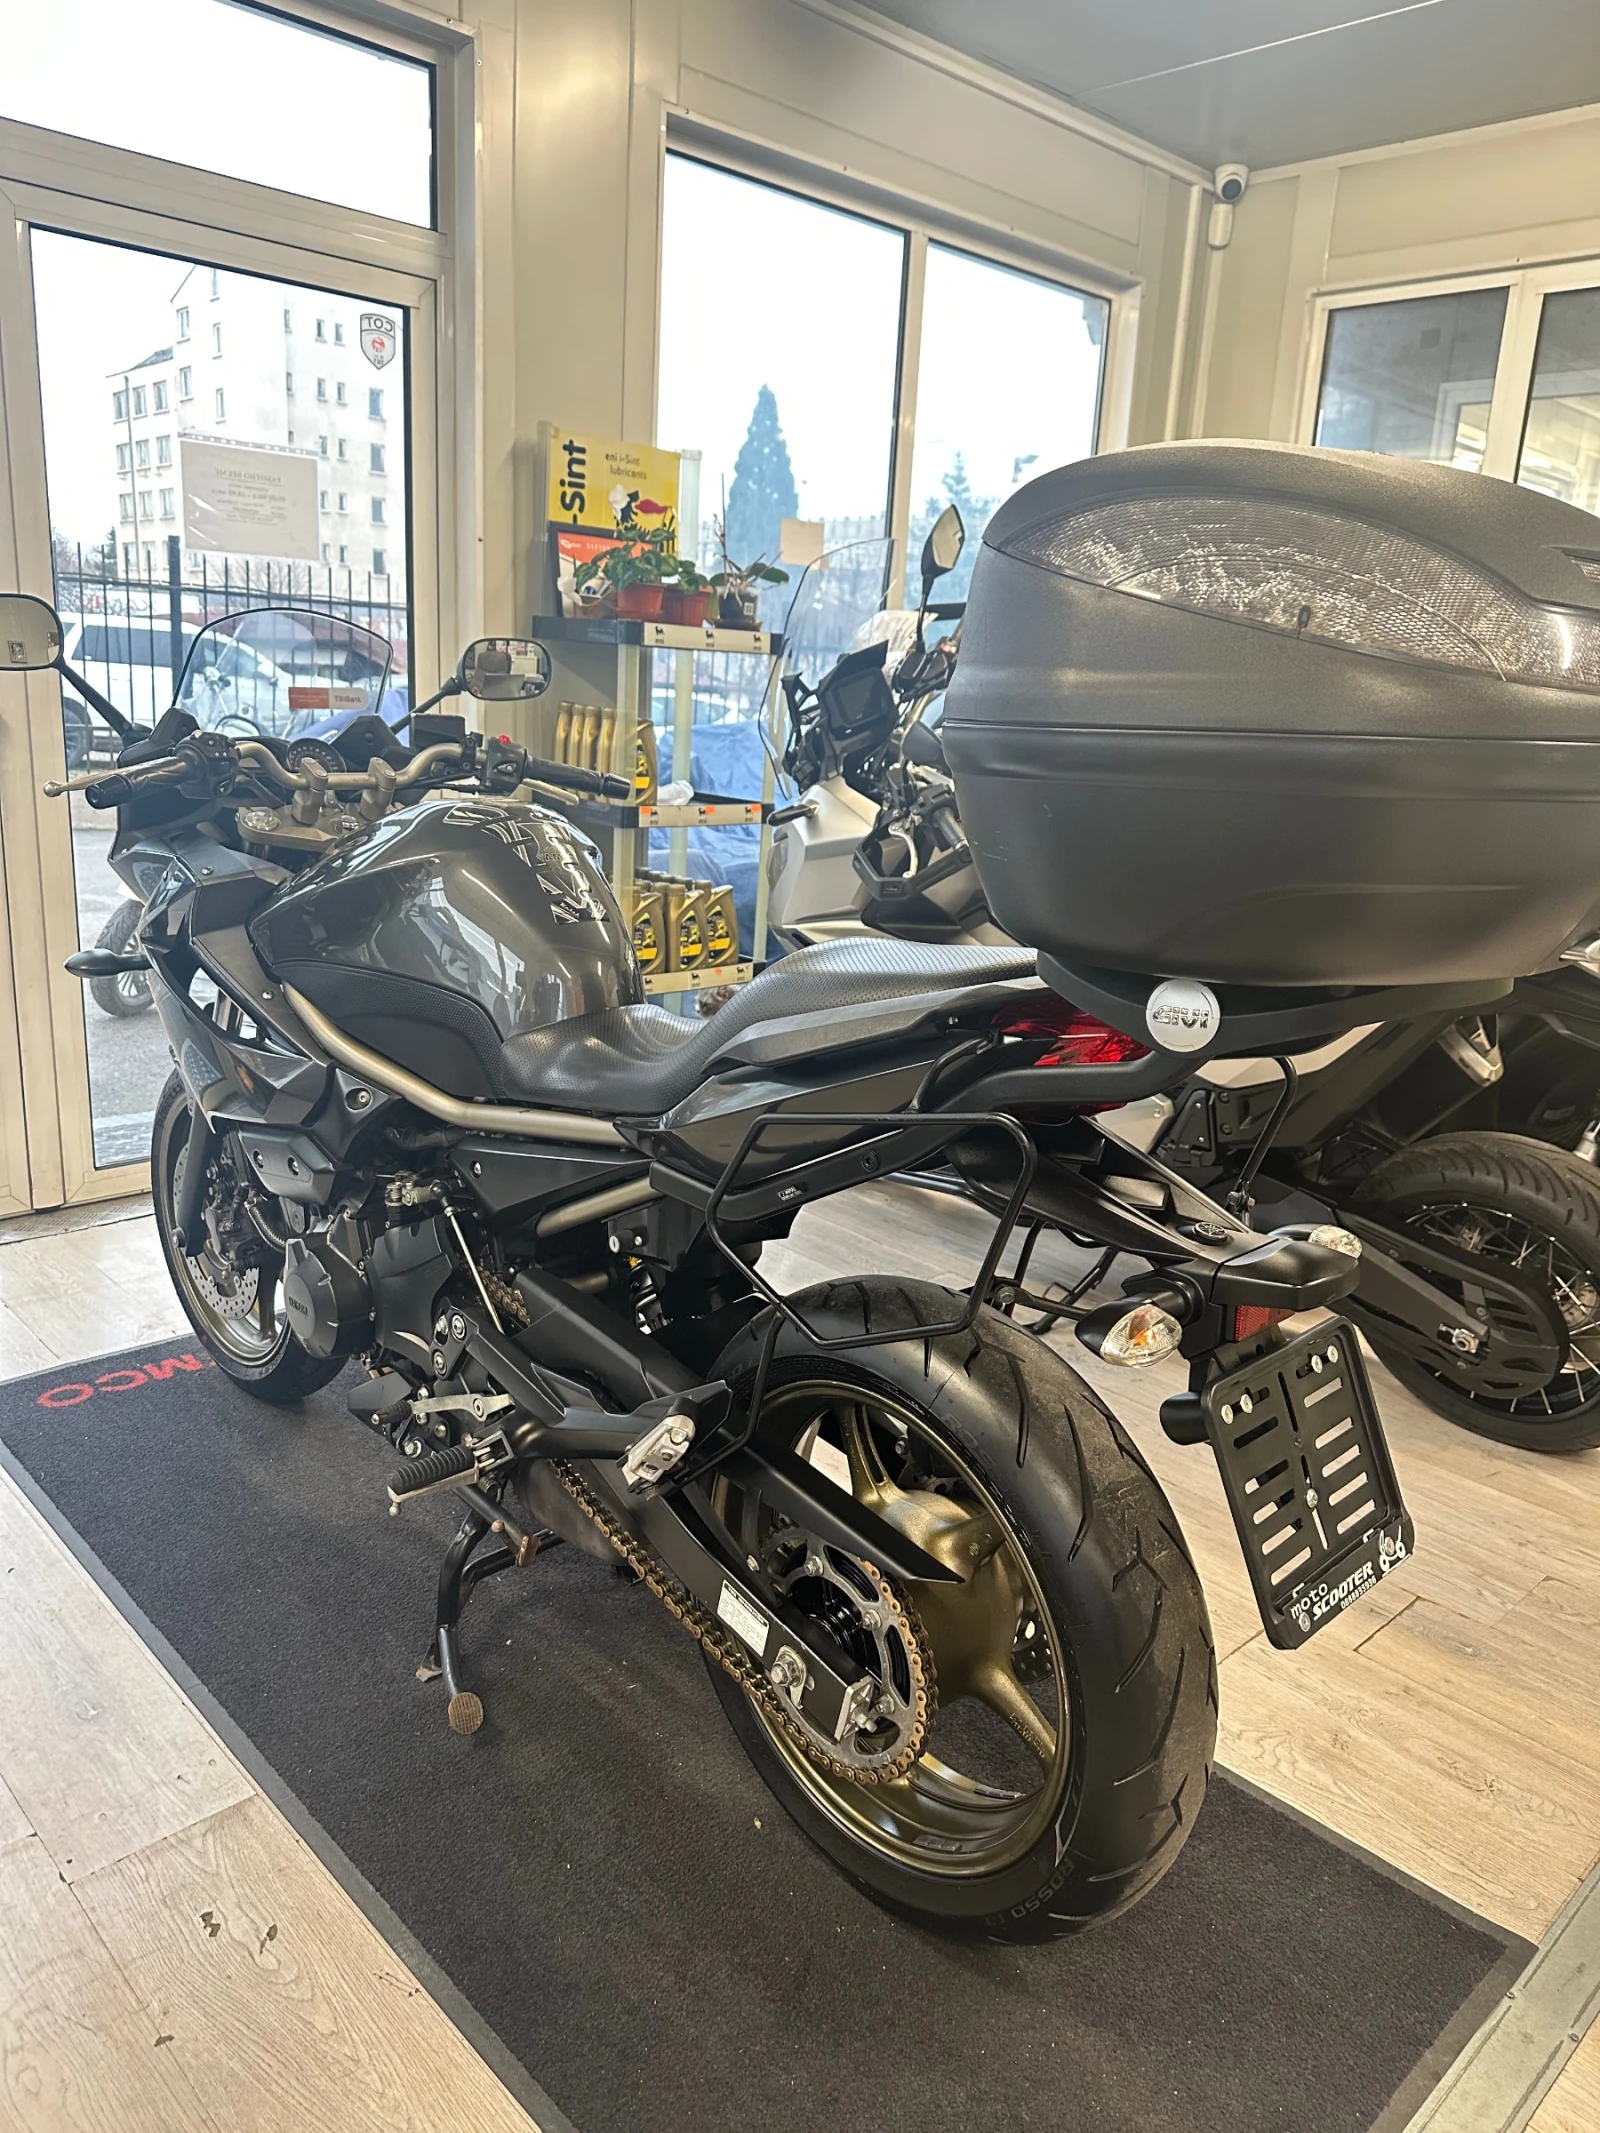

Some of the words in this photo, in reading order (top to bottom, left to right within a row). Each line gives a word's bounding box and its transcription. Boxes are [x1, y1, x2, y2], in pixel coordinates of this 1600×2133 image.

[605, 452, 618, 462] eni
[619, 452, 641, 467] i-Sint
[609, 465, 648, 481] lubricants
[1152, 1004, 1210, 1030] GIVI
[37, 1353, 216, 1408] MCO
[1290, 1583, 1329, 1620] moto
[1312, 1561, 1375, 1621] SCOOTER
[1010, 1855, 1076, 1919] ROSSO
